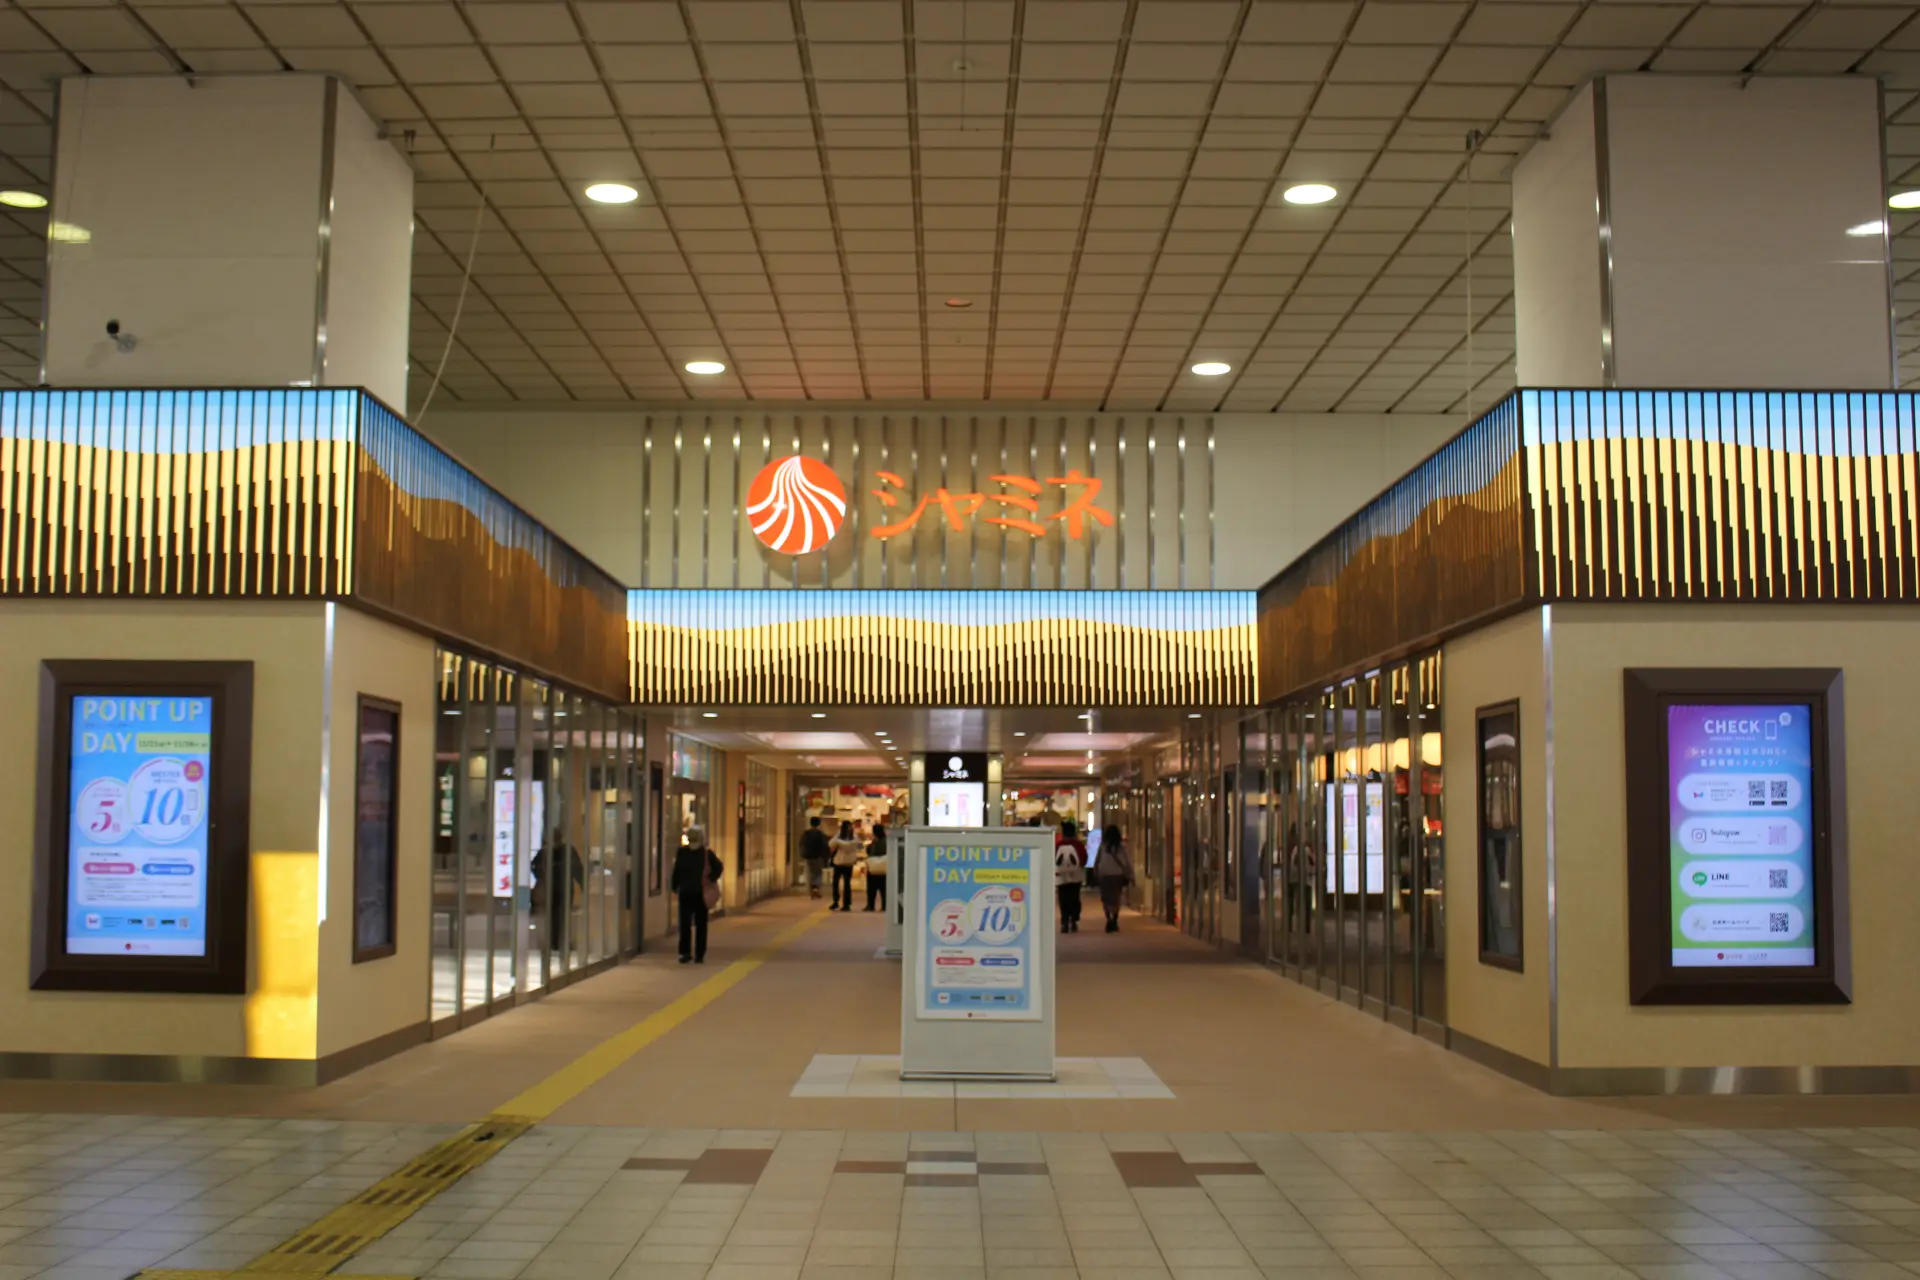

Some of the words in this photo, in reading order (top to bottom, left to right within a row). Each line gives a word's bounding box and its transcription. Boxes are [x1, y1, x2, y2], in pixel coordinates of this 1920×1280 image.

[870, 470, 1114, 539] シャミネ
[83, 700, 162, 721] POINT
[169, 700, 204, 722] UP
[1704, 719, 1760, 734] CHECK
[83, 731, 133, 753] DAY
[934, 846, 992, 862] POINT
[998, 846, 1023, 862] UP
[934, 868, 971, 883] DAY
[1711, 873, 1730, 881] LINE
